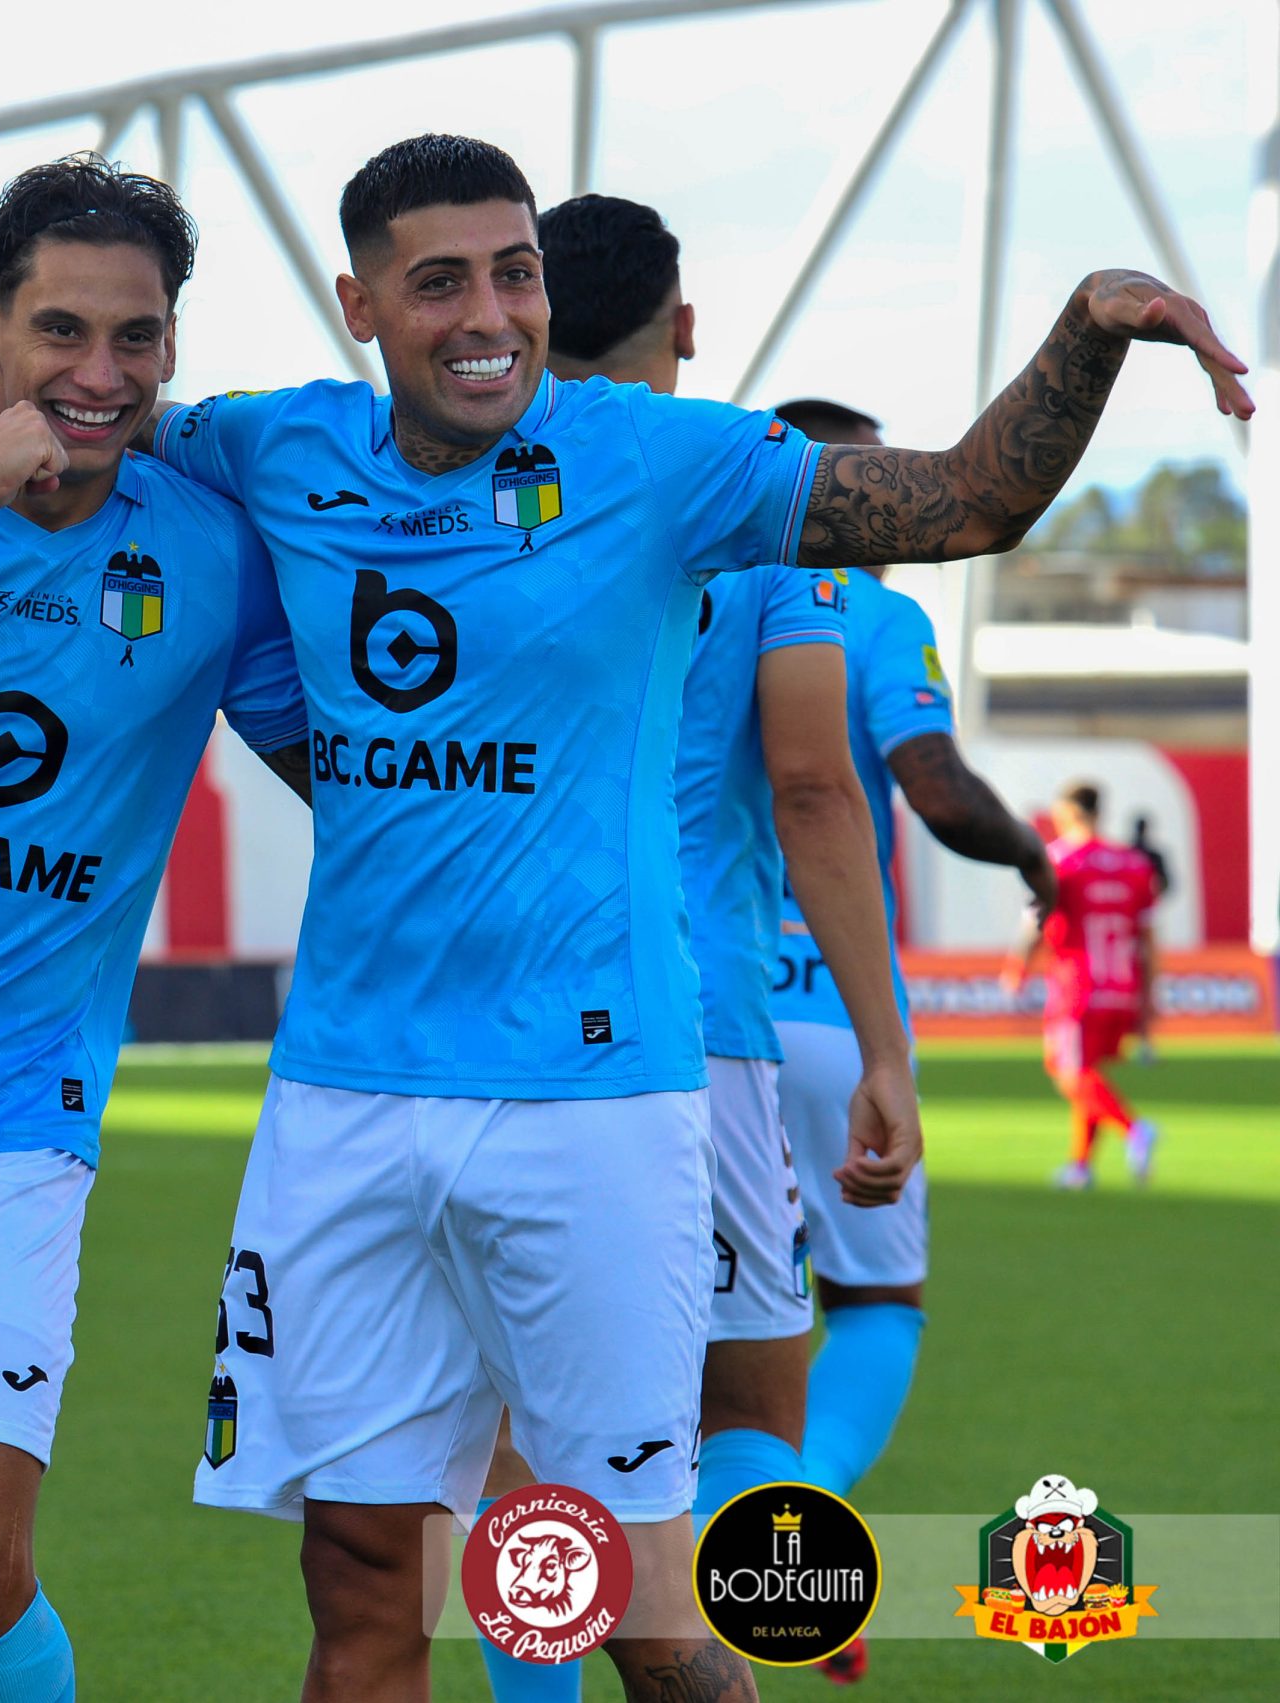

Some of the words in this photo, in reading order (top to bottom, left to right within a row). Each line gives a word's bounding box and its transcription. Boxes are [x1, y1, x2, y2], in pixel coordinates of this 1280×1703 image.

[498, 472, 555, 488] O'HIGGINS
[107, 579, 160, 595] O'HIGGINS
[313, 729, 537, 795] BC.GAME
